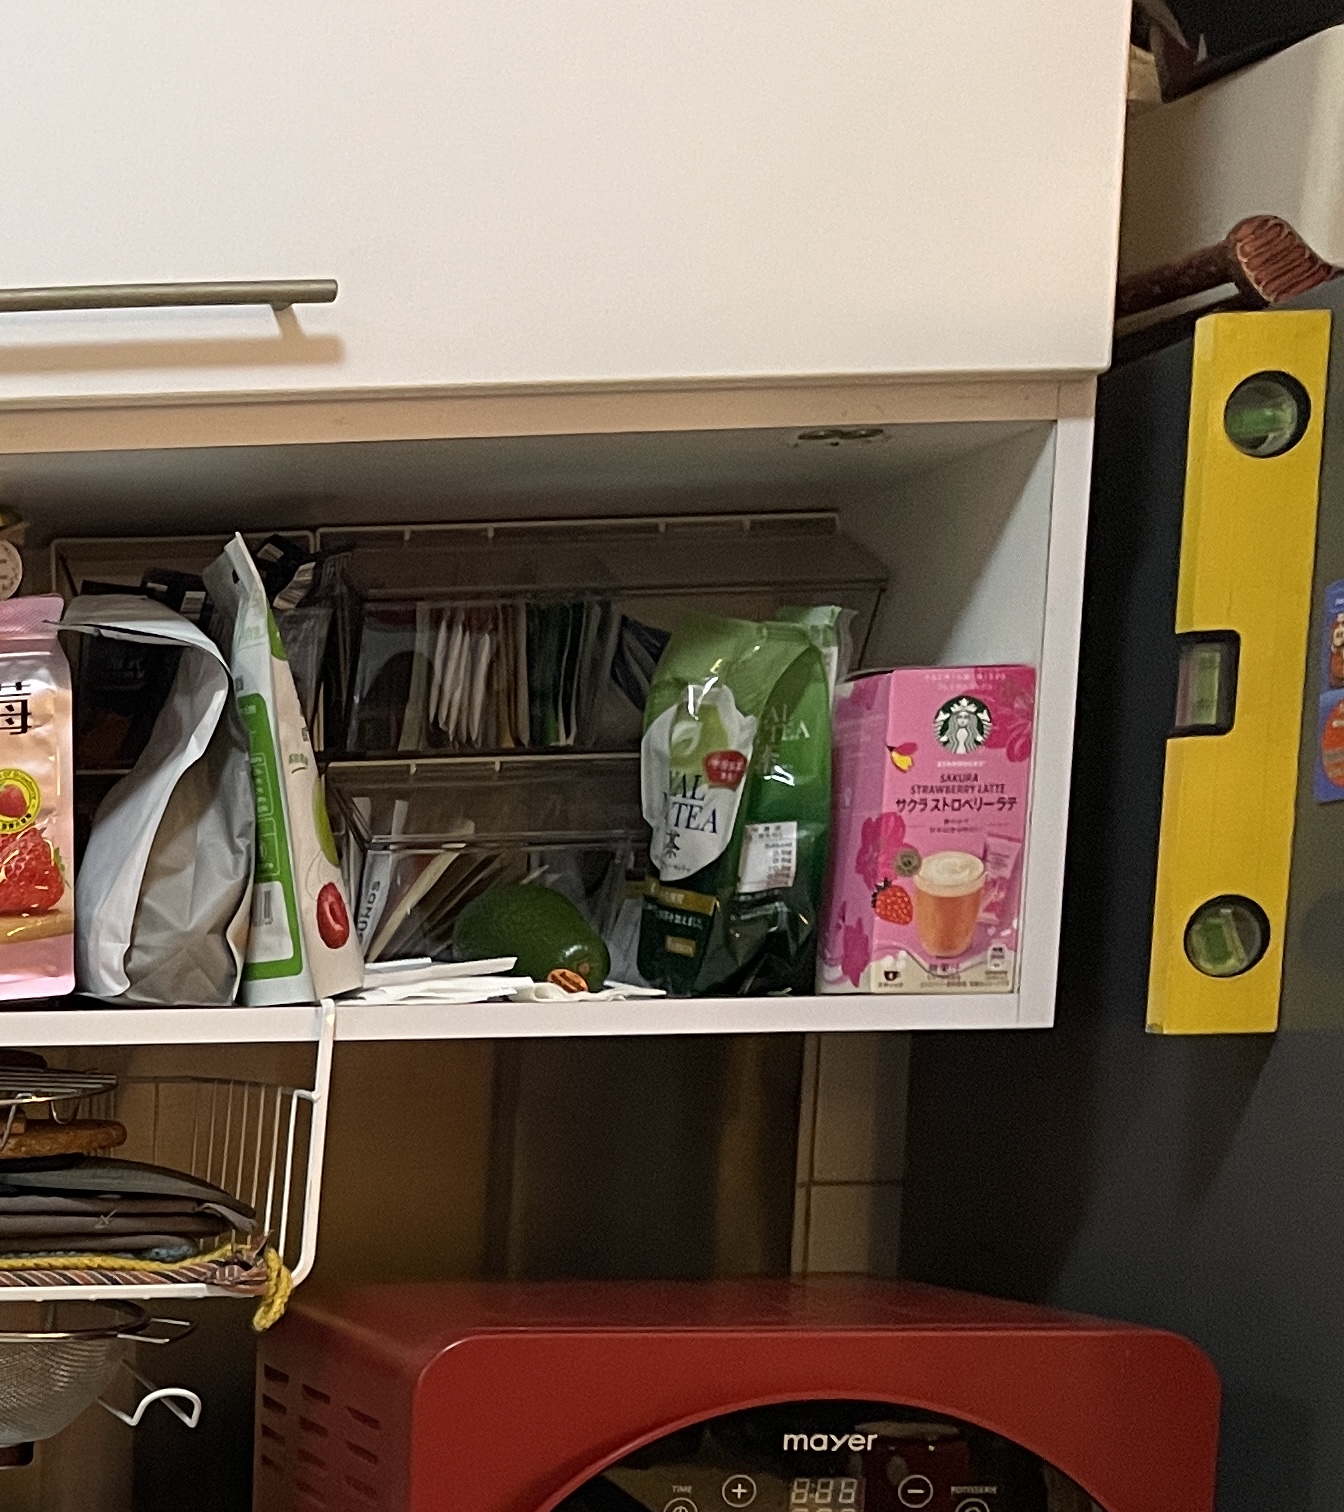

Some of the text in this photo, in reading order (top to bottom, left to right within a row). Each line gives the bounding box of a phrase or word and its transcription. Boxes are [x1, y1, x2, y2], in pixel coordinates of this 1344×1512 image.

[939, 773, 979, 783] SAKURA
[911, 783, 1006, 795] STRAWBERRY LATTE
[672, 802, 718, 834] TEA
[783, 1432, 878, 1452] mayer
[671, 1485, 693, 1494] TIME
